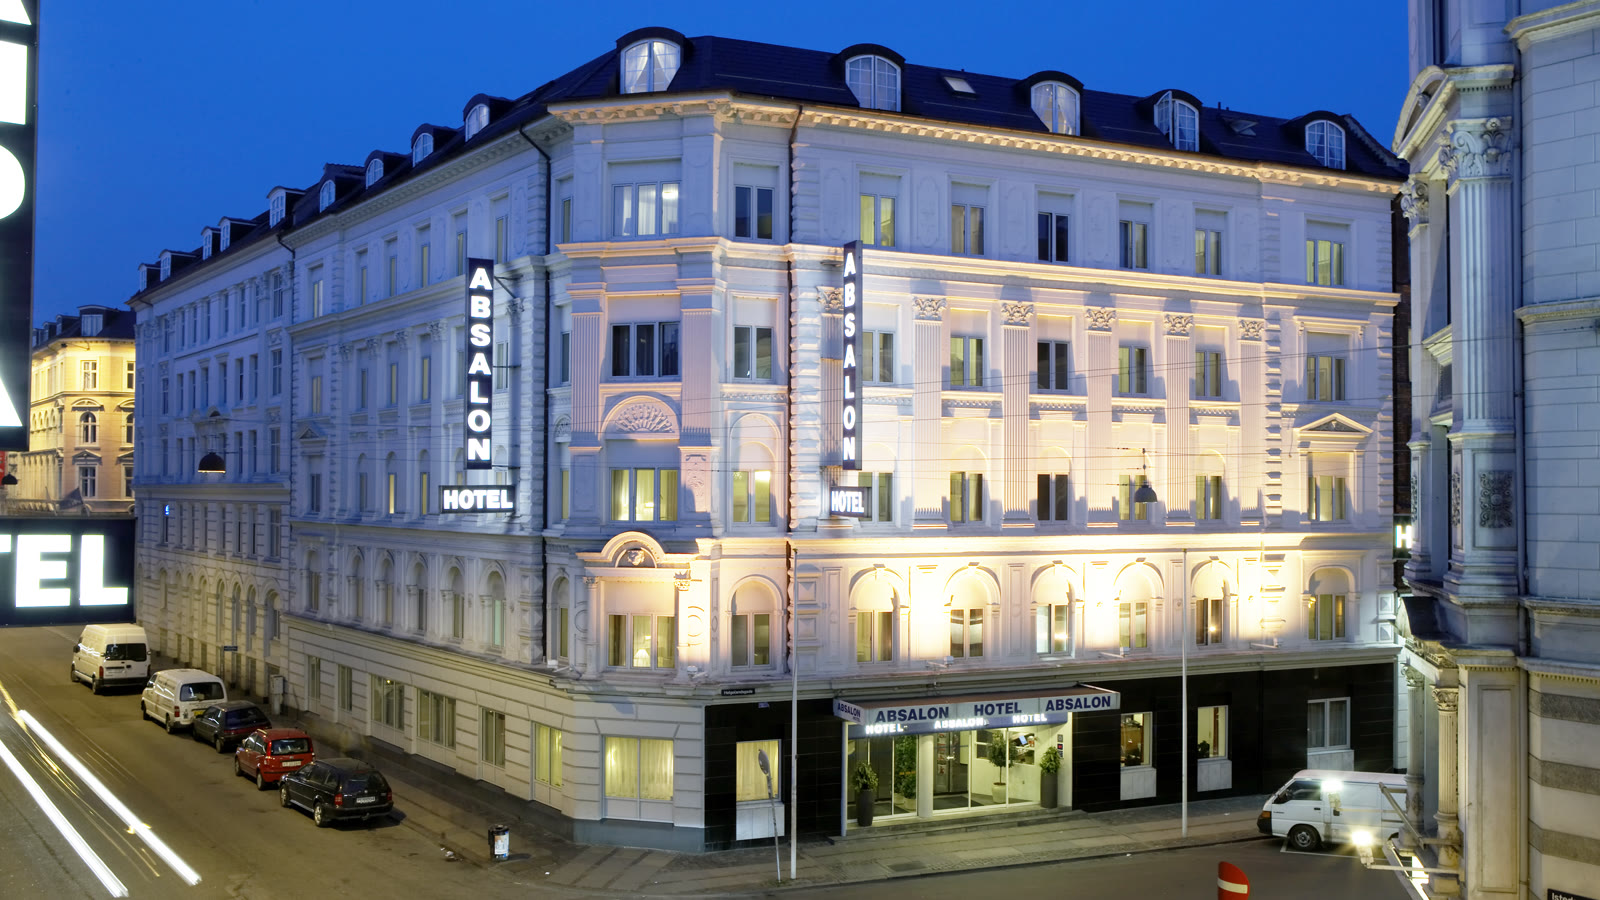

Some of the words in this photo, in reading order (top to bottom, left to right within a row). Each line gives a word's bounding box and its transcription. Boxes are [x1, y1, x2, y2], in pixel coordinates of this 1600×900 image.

[468, 267, 493, 461] ABSALON
[842, 252, 857, 461] ABSALON
[443, 488, 514, 510] HOTEL
[830, 490, 865, 513] HOTEL
[0, 534, 129, 608] EL
[838, 702, 861, 718] ABSALON
[875, 706, 949, 723] ABSALON
[974, 702, 1022, 716] HOTEL
[1045, 695, 1111, 711] ABSALON
[865, 723, 904, 735] HOTEL
[934, 718, 984, 729] ABSALON
[1012, 713, 1047, 724] HOTEL
